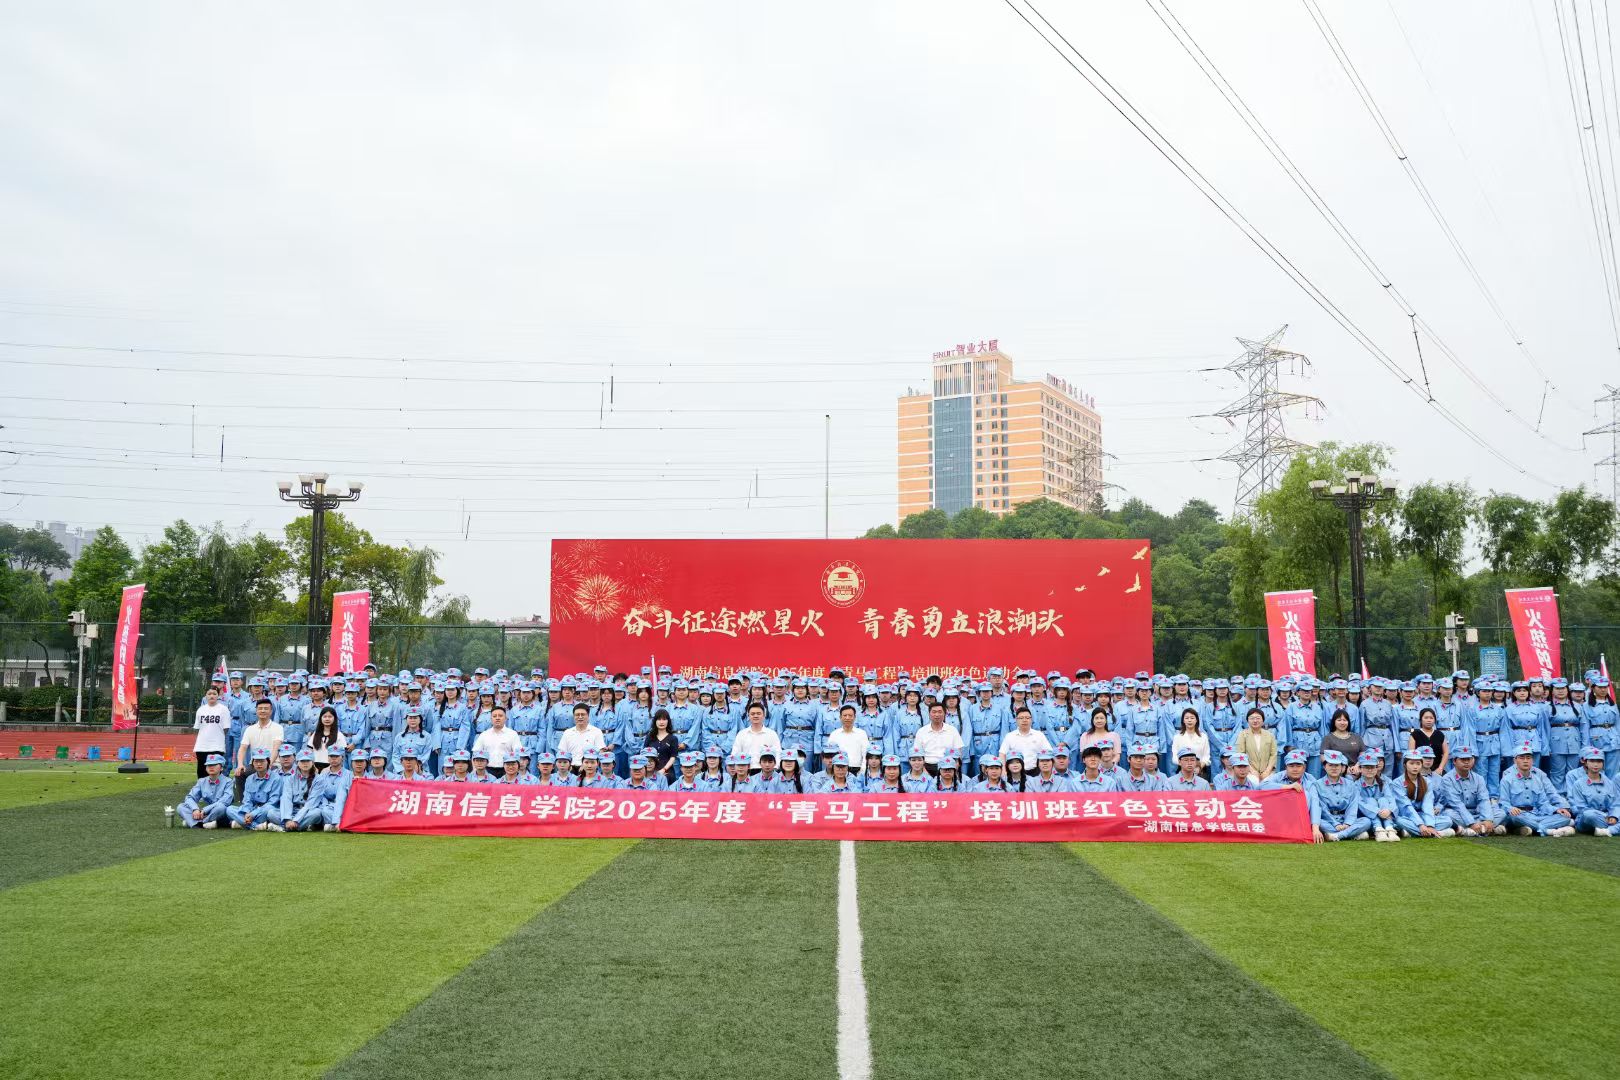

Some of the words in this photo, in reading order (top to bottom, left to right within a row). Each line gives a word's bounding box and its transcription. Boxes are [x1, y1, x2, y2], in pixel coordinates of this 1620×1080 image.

[621, 607, 825, 638] 奋斗征途燃星火
[857, 606, 1065, 639] 青春勇立浪潮头
